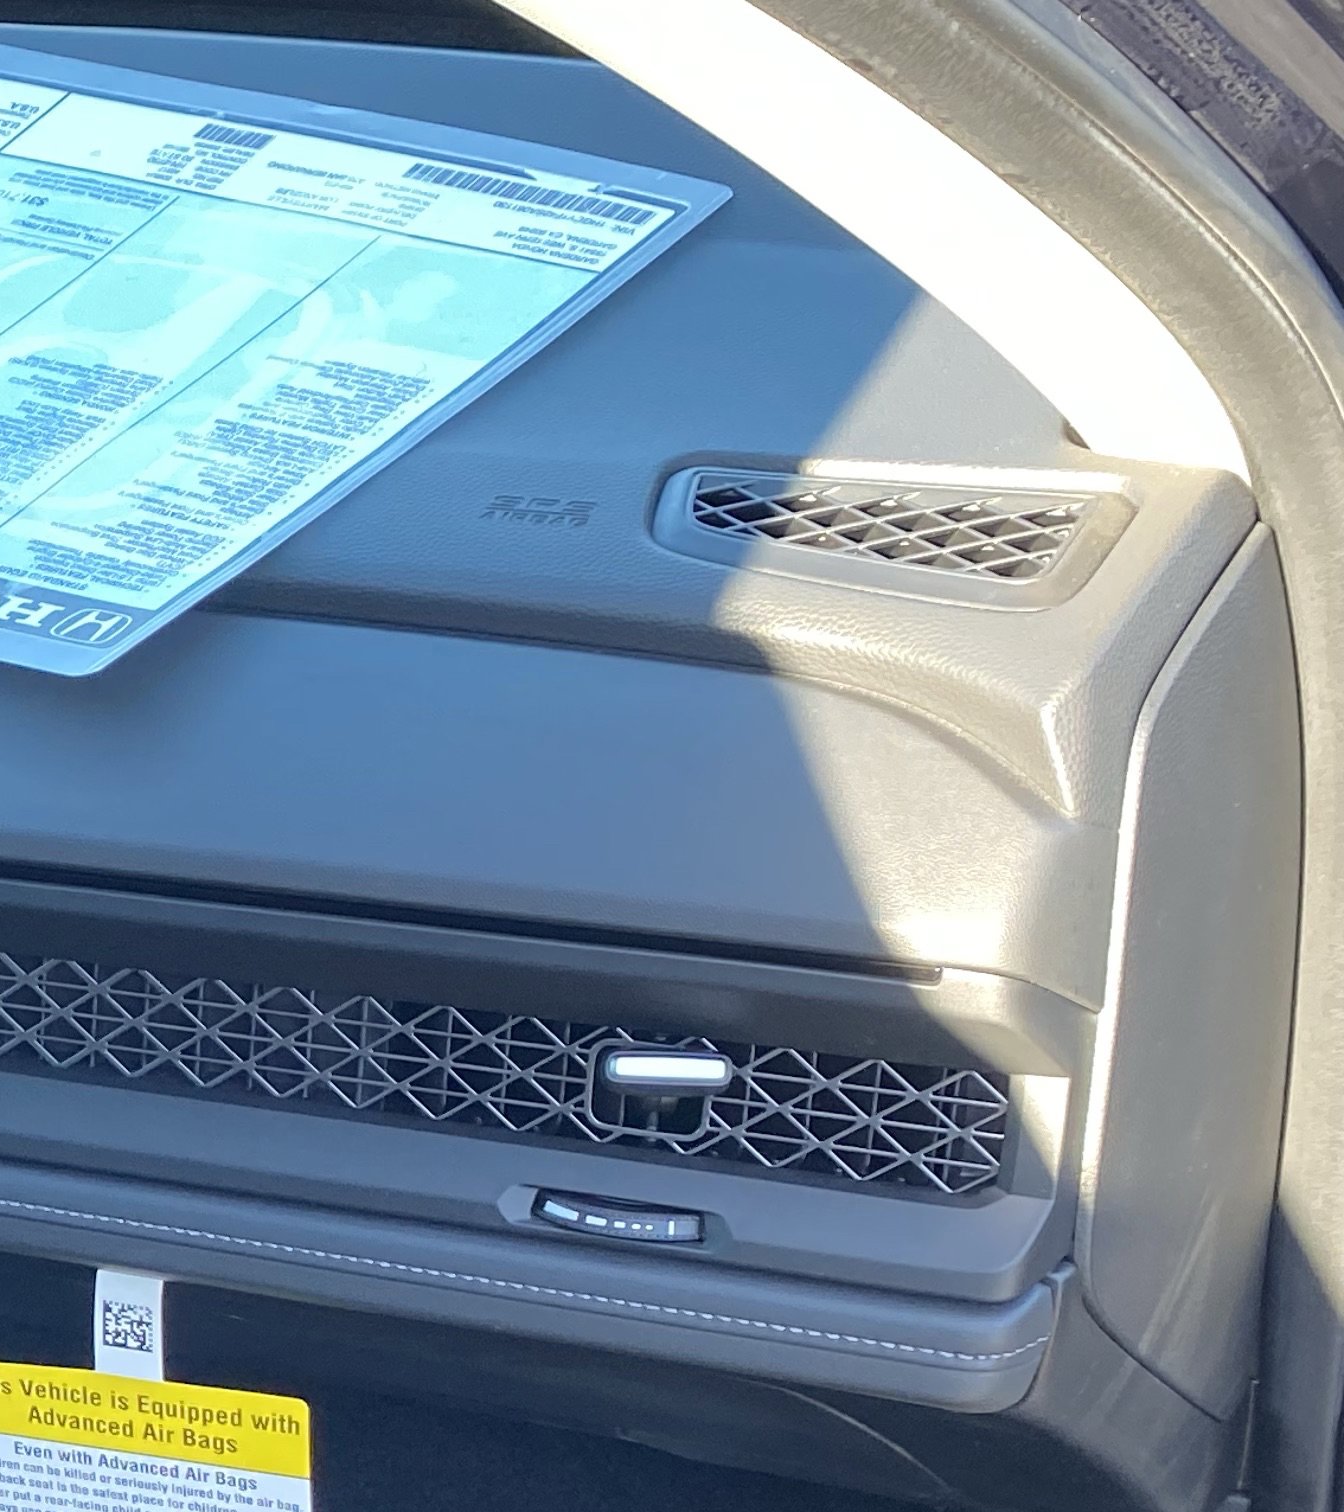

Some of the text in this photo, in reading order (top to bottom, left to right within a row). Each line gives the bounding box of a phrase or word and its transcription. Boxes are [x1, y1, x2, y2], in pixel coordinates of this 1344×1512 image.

[478, 509, 591, 527] AIRBAG
[18, 1379, 101, 1406] Vehicle
[110, 1390, 129, 1410] is
[136, 1394, 242, 1430] Equipped
[251, 1410, 300, 1435] with
[27, 1405, 238, 1455] Advanced Air Bags
[13, 1441, 257, 1492] Even with Advanced Air Bags
[23, 1463, 43, 1473] can
[46, 1464, 60, 1476] be
[64, 1467, 96, 1481] killed
[99, 1474, 112, 1483] or
[114, 1474, 168, 1494] seriously
[171, 1483, 213, 1500] injured
[216, 1490, 231, 1503] by
[234, 1493, 253, 1505] the
[256, 1496, 273, 1508] air
[12, 1489, 31, 1502] put
[28, 1477, 53, 1489] seat
[70, 1483, 88, 1495] the
[92, 1487, 128, 1501] safest
[131, 1493, 163, 1508] place
[167, 1498, 184, 1509] for
